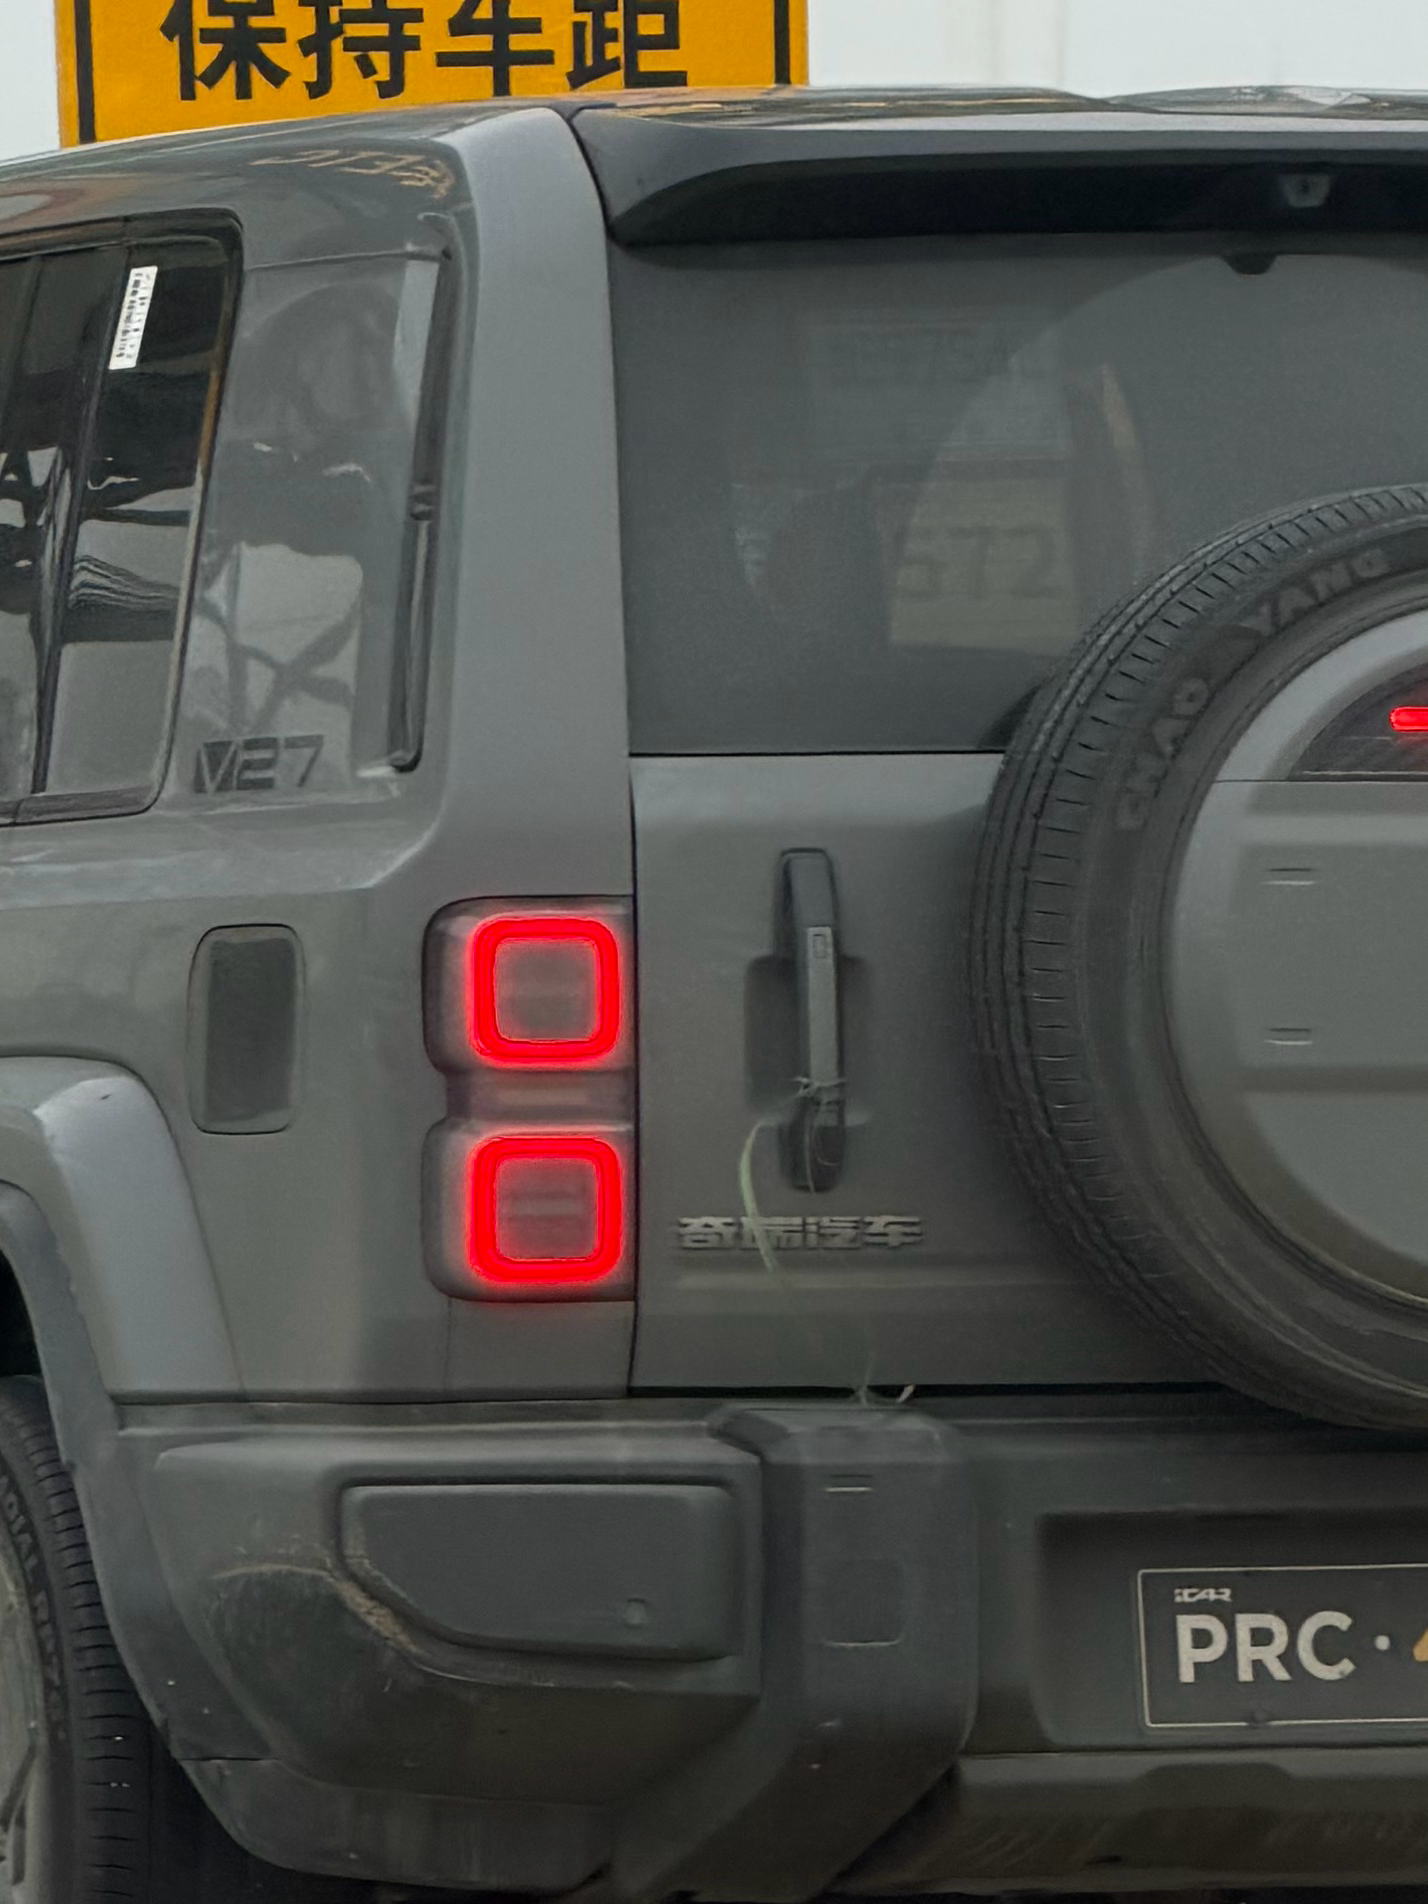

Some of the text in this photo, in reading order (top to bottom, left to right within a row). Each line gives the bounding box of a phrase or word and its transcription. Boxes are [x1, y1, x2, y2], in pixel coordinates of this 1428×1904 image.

[1239, 547, 1393, 638] YANG
[193, 733, 325, 794] V27
[676, 1213, 925, 1251] 奇瑞汽车
